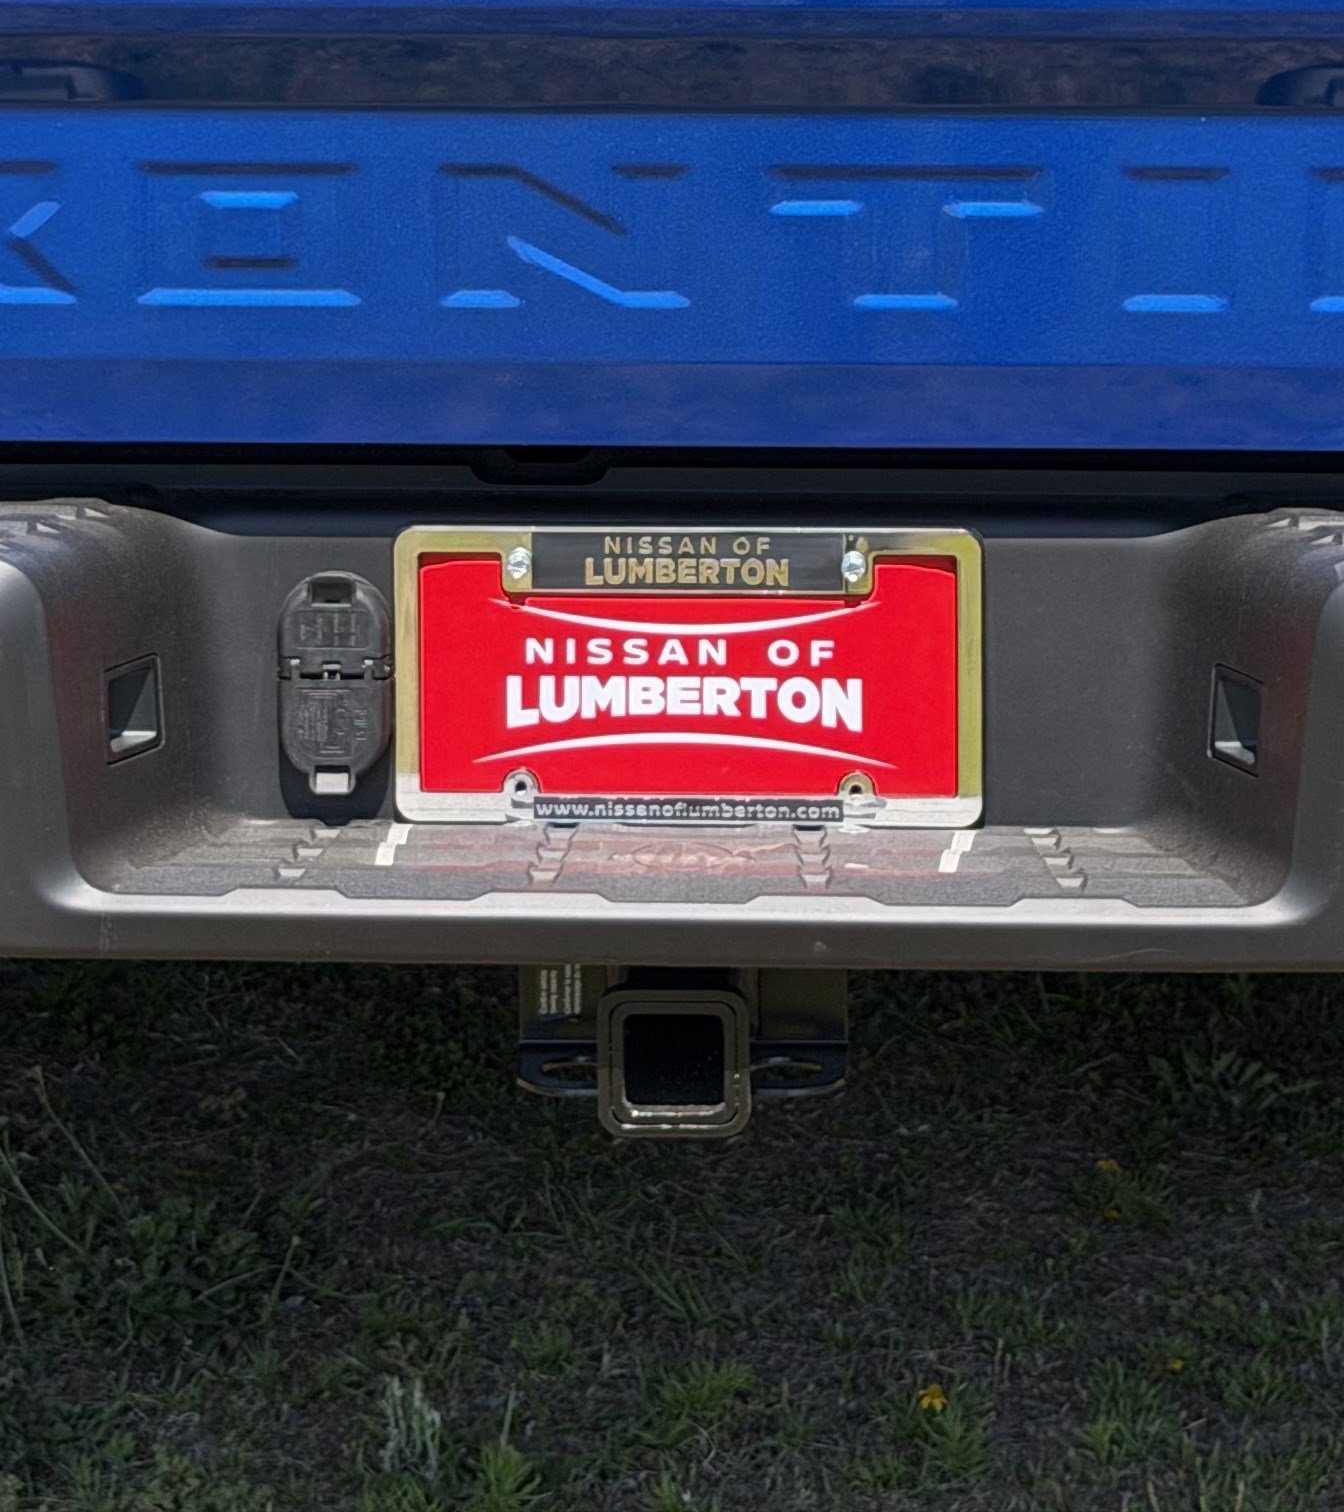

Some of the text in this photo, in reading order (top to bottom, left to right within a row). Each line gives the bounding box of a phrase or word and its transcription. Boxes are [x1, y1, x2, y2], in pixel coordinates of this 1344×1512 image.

[604, 536, 771, 555] NISSAN OF
[585, 557, 790, 587] LUMBERTON
[525, 637, 836, 667] NISSAN OF
[505, 674, 863, 733] LUMBERTON
[534, 799, 842, 820] www.nissanoflumberton.com
